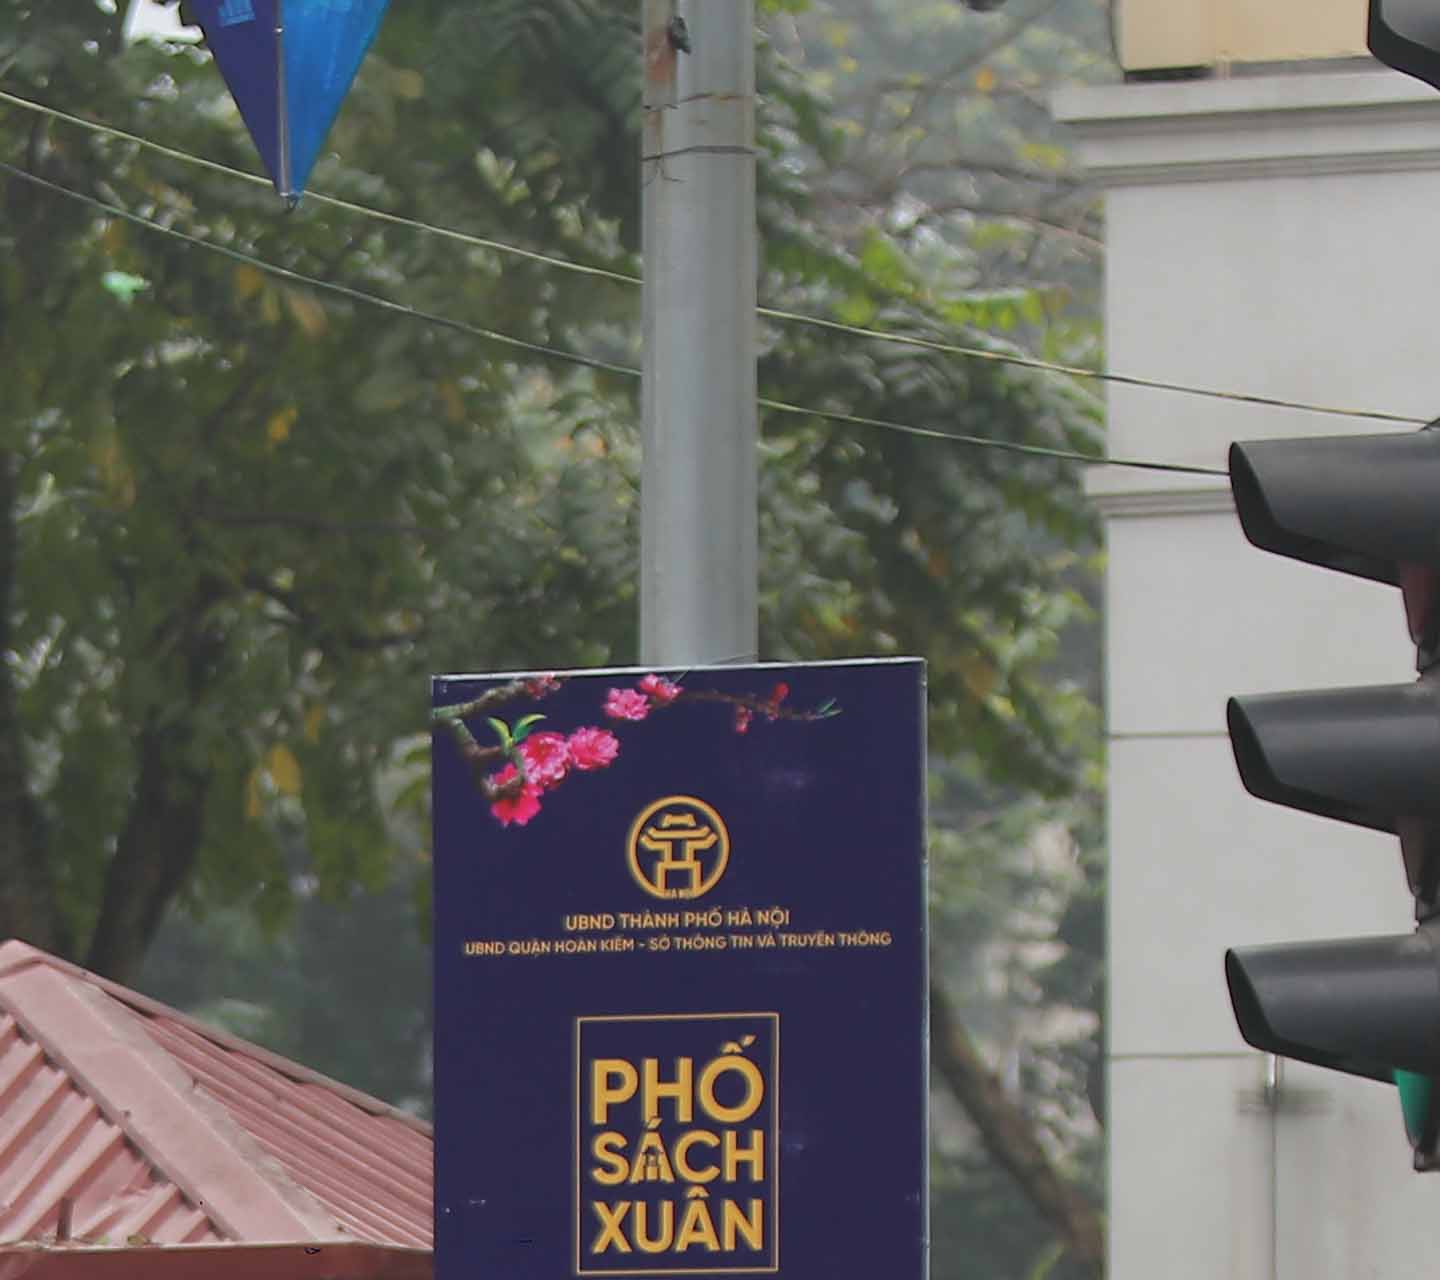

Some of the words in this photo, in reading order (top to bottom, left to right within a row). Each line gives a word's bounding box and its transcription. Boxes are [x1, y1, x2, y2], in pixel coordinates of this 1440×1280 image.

[464, 940, 506, 956] UBND
[508, 938, 551, 958] QUẬN
[554, 935, 597, 954] HOÀN
[731, 934, 753, 949] TIN
[756, 930, 777, 948] VÀ
[839, 929, 893, 946] THÔNG
[564, 914, 616, 932] UBND
[620, 909, 680, 929] THÀNH
[684, 905, 723, 928] PHỐ
[727, 906, 753, 928] HÀ
[757, 906, 790, 929] NỘI
[591, 1034, 766, 1125] PHỐ
[591, 1117, 765, 1185] SÁCH
[591, 1184, 764, 1254] XUÂN
